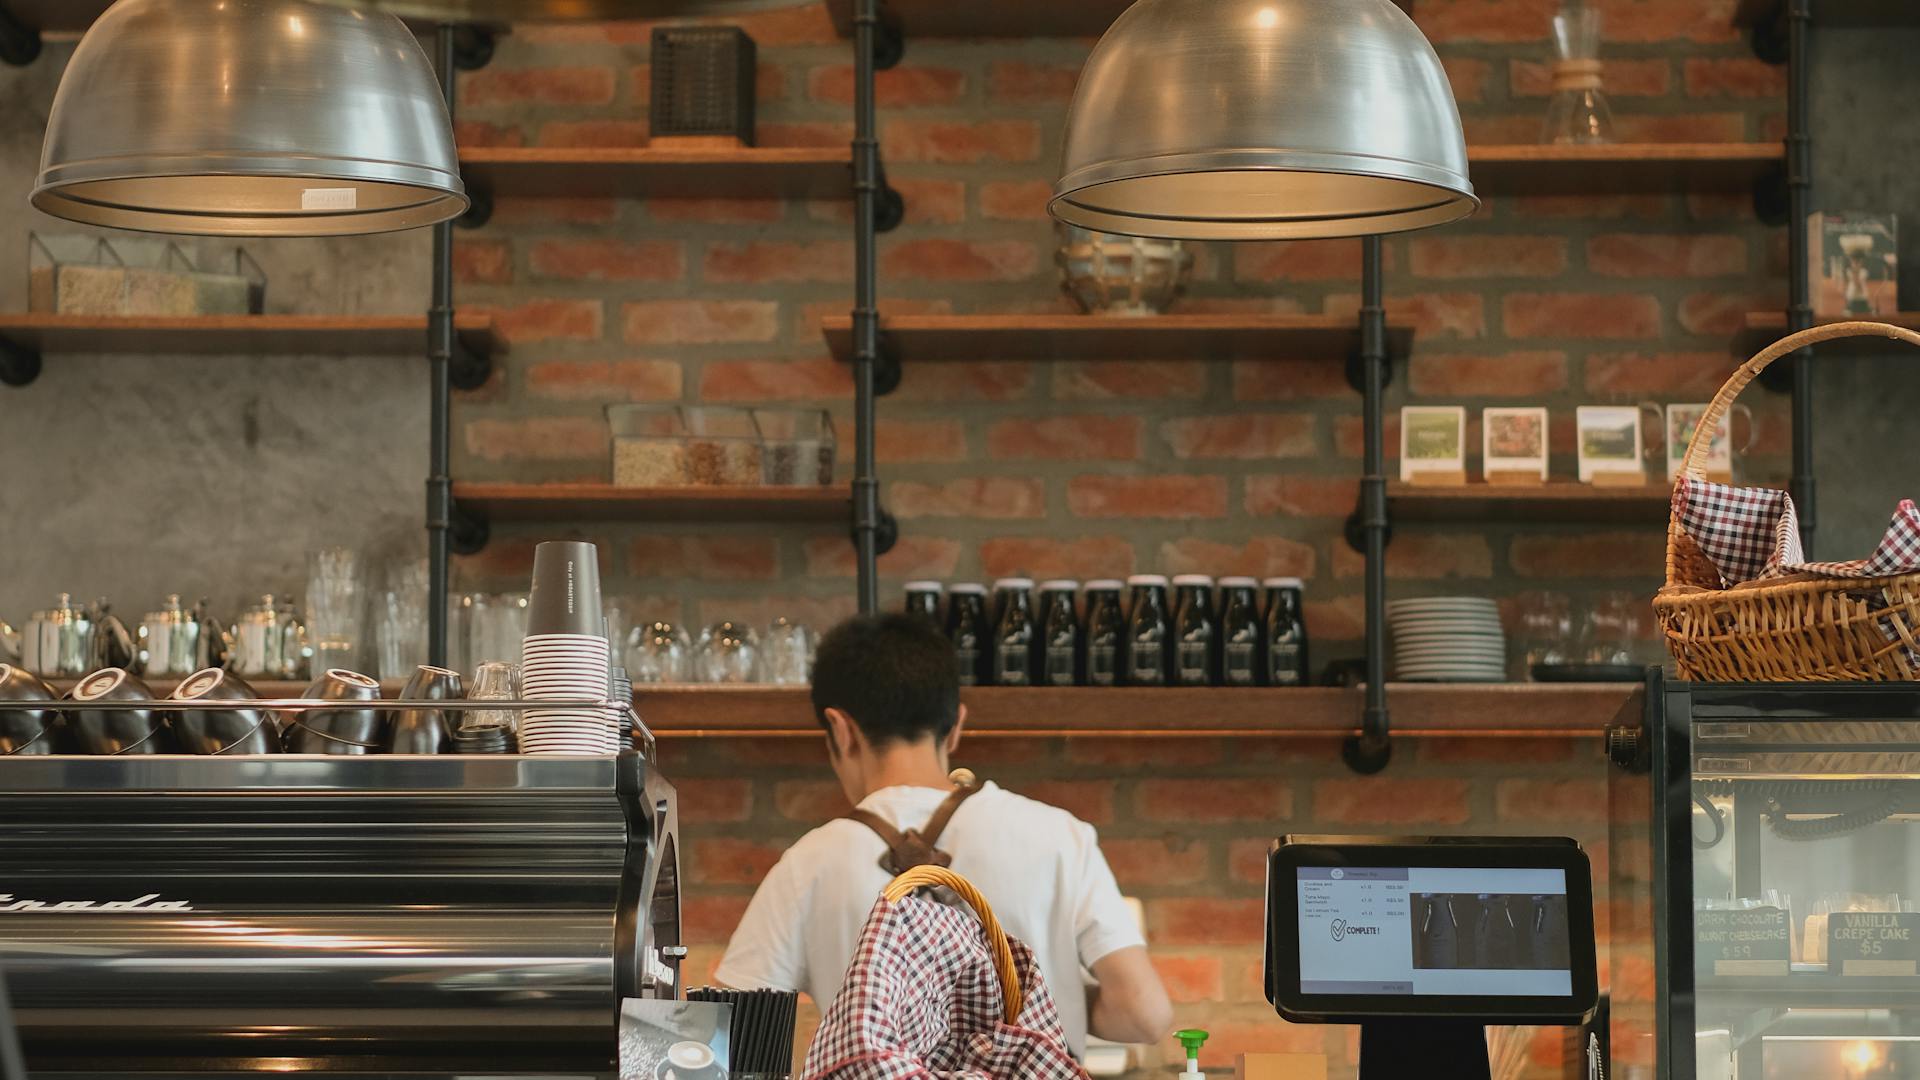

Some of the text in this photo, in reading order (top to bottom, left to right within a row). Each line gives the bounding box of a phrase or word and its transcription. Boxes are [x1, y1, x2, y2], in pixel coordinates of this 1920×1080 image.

[1844, 914, 1900, 928] VANILLA
[1834, 927, 1911, 941] CREPE CAKE
[1859, 938, 1882, 956] $5
